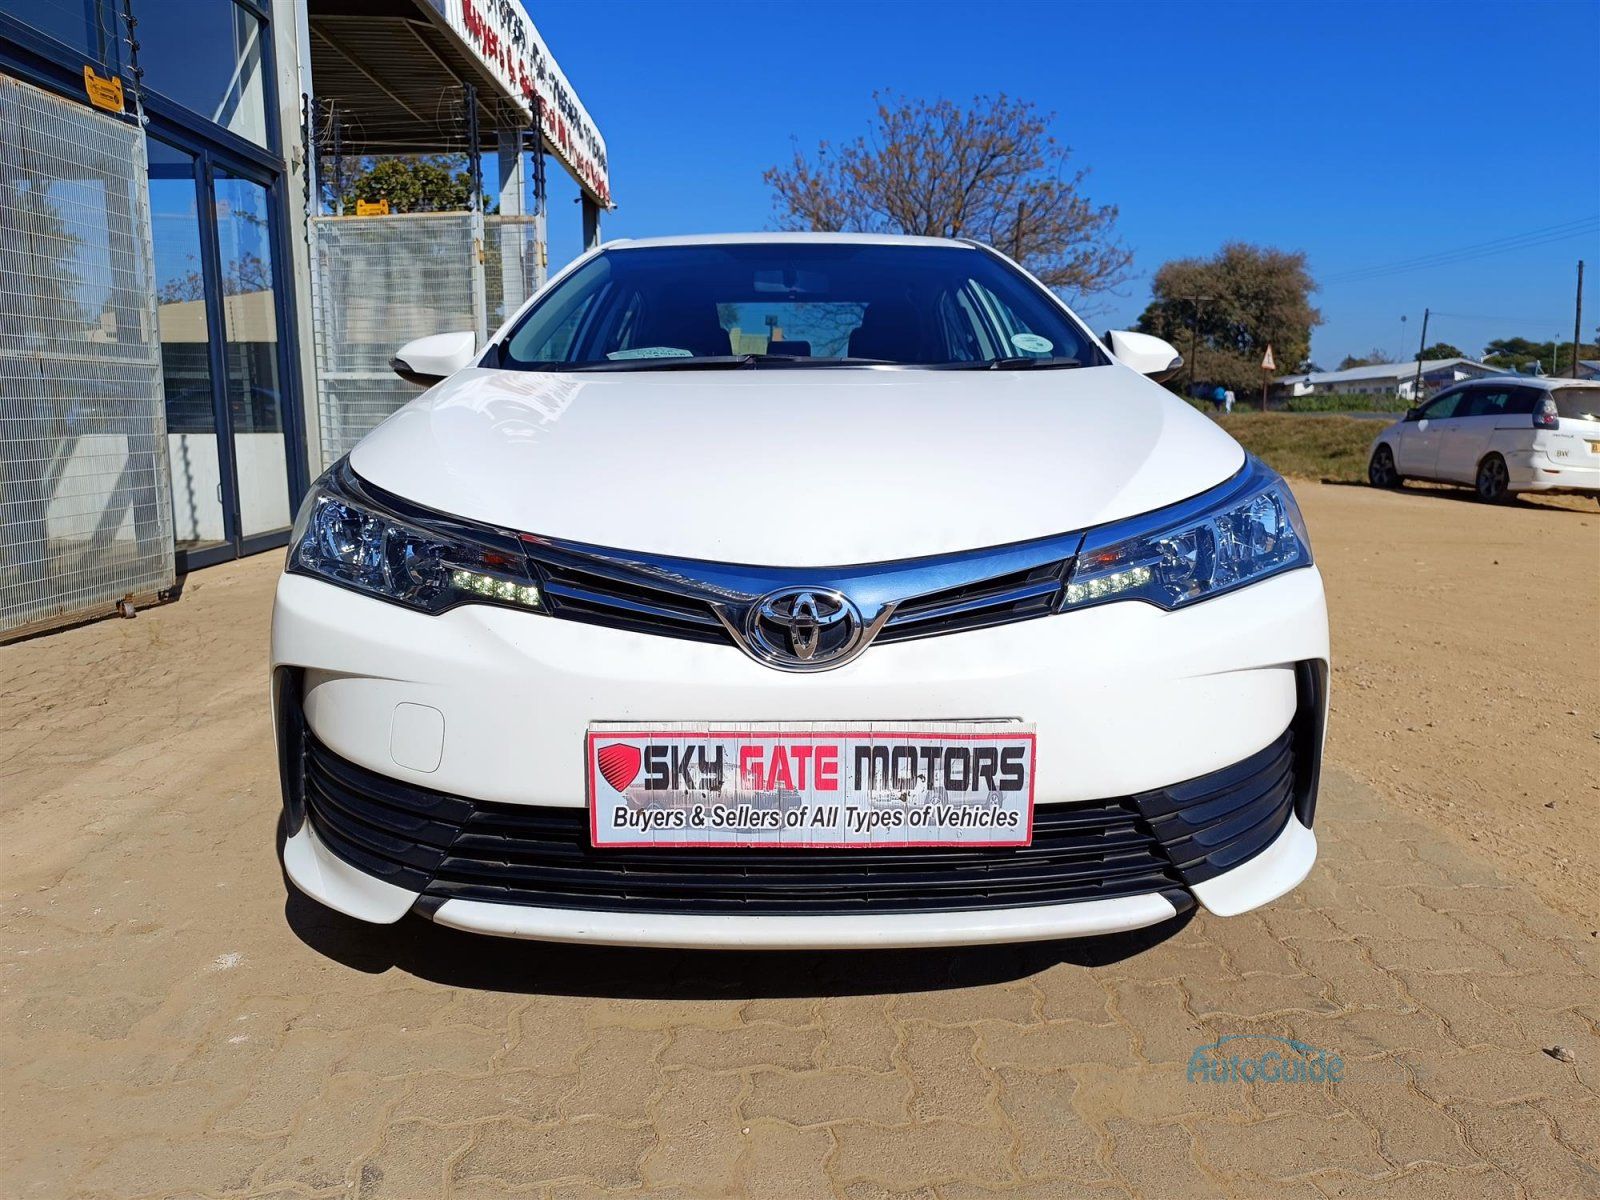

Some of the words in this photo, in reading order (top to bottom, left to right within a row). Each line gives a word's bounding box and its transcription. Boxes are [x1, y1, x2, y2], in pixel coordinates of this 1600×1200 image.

[644, 745, 723, 791] SKY
[739, 745, 837, 791] GATE
[854, 745, 1025, 791] MOTORS
[613, 807, 685, 833] Buyers
[691, 806, 707, 826] &
[712, 805, 782, 828] Sellers
[787, 805, 806, 827] of
[811, 805, 838, 827] All
[846, 807, 902, 833] Types
[909, 805, 930, 827] of
[937, 805, 1019, 828] Vehicles
